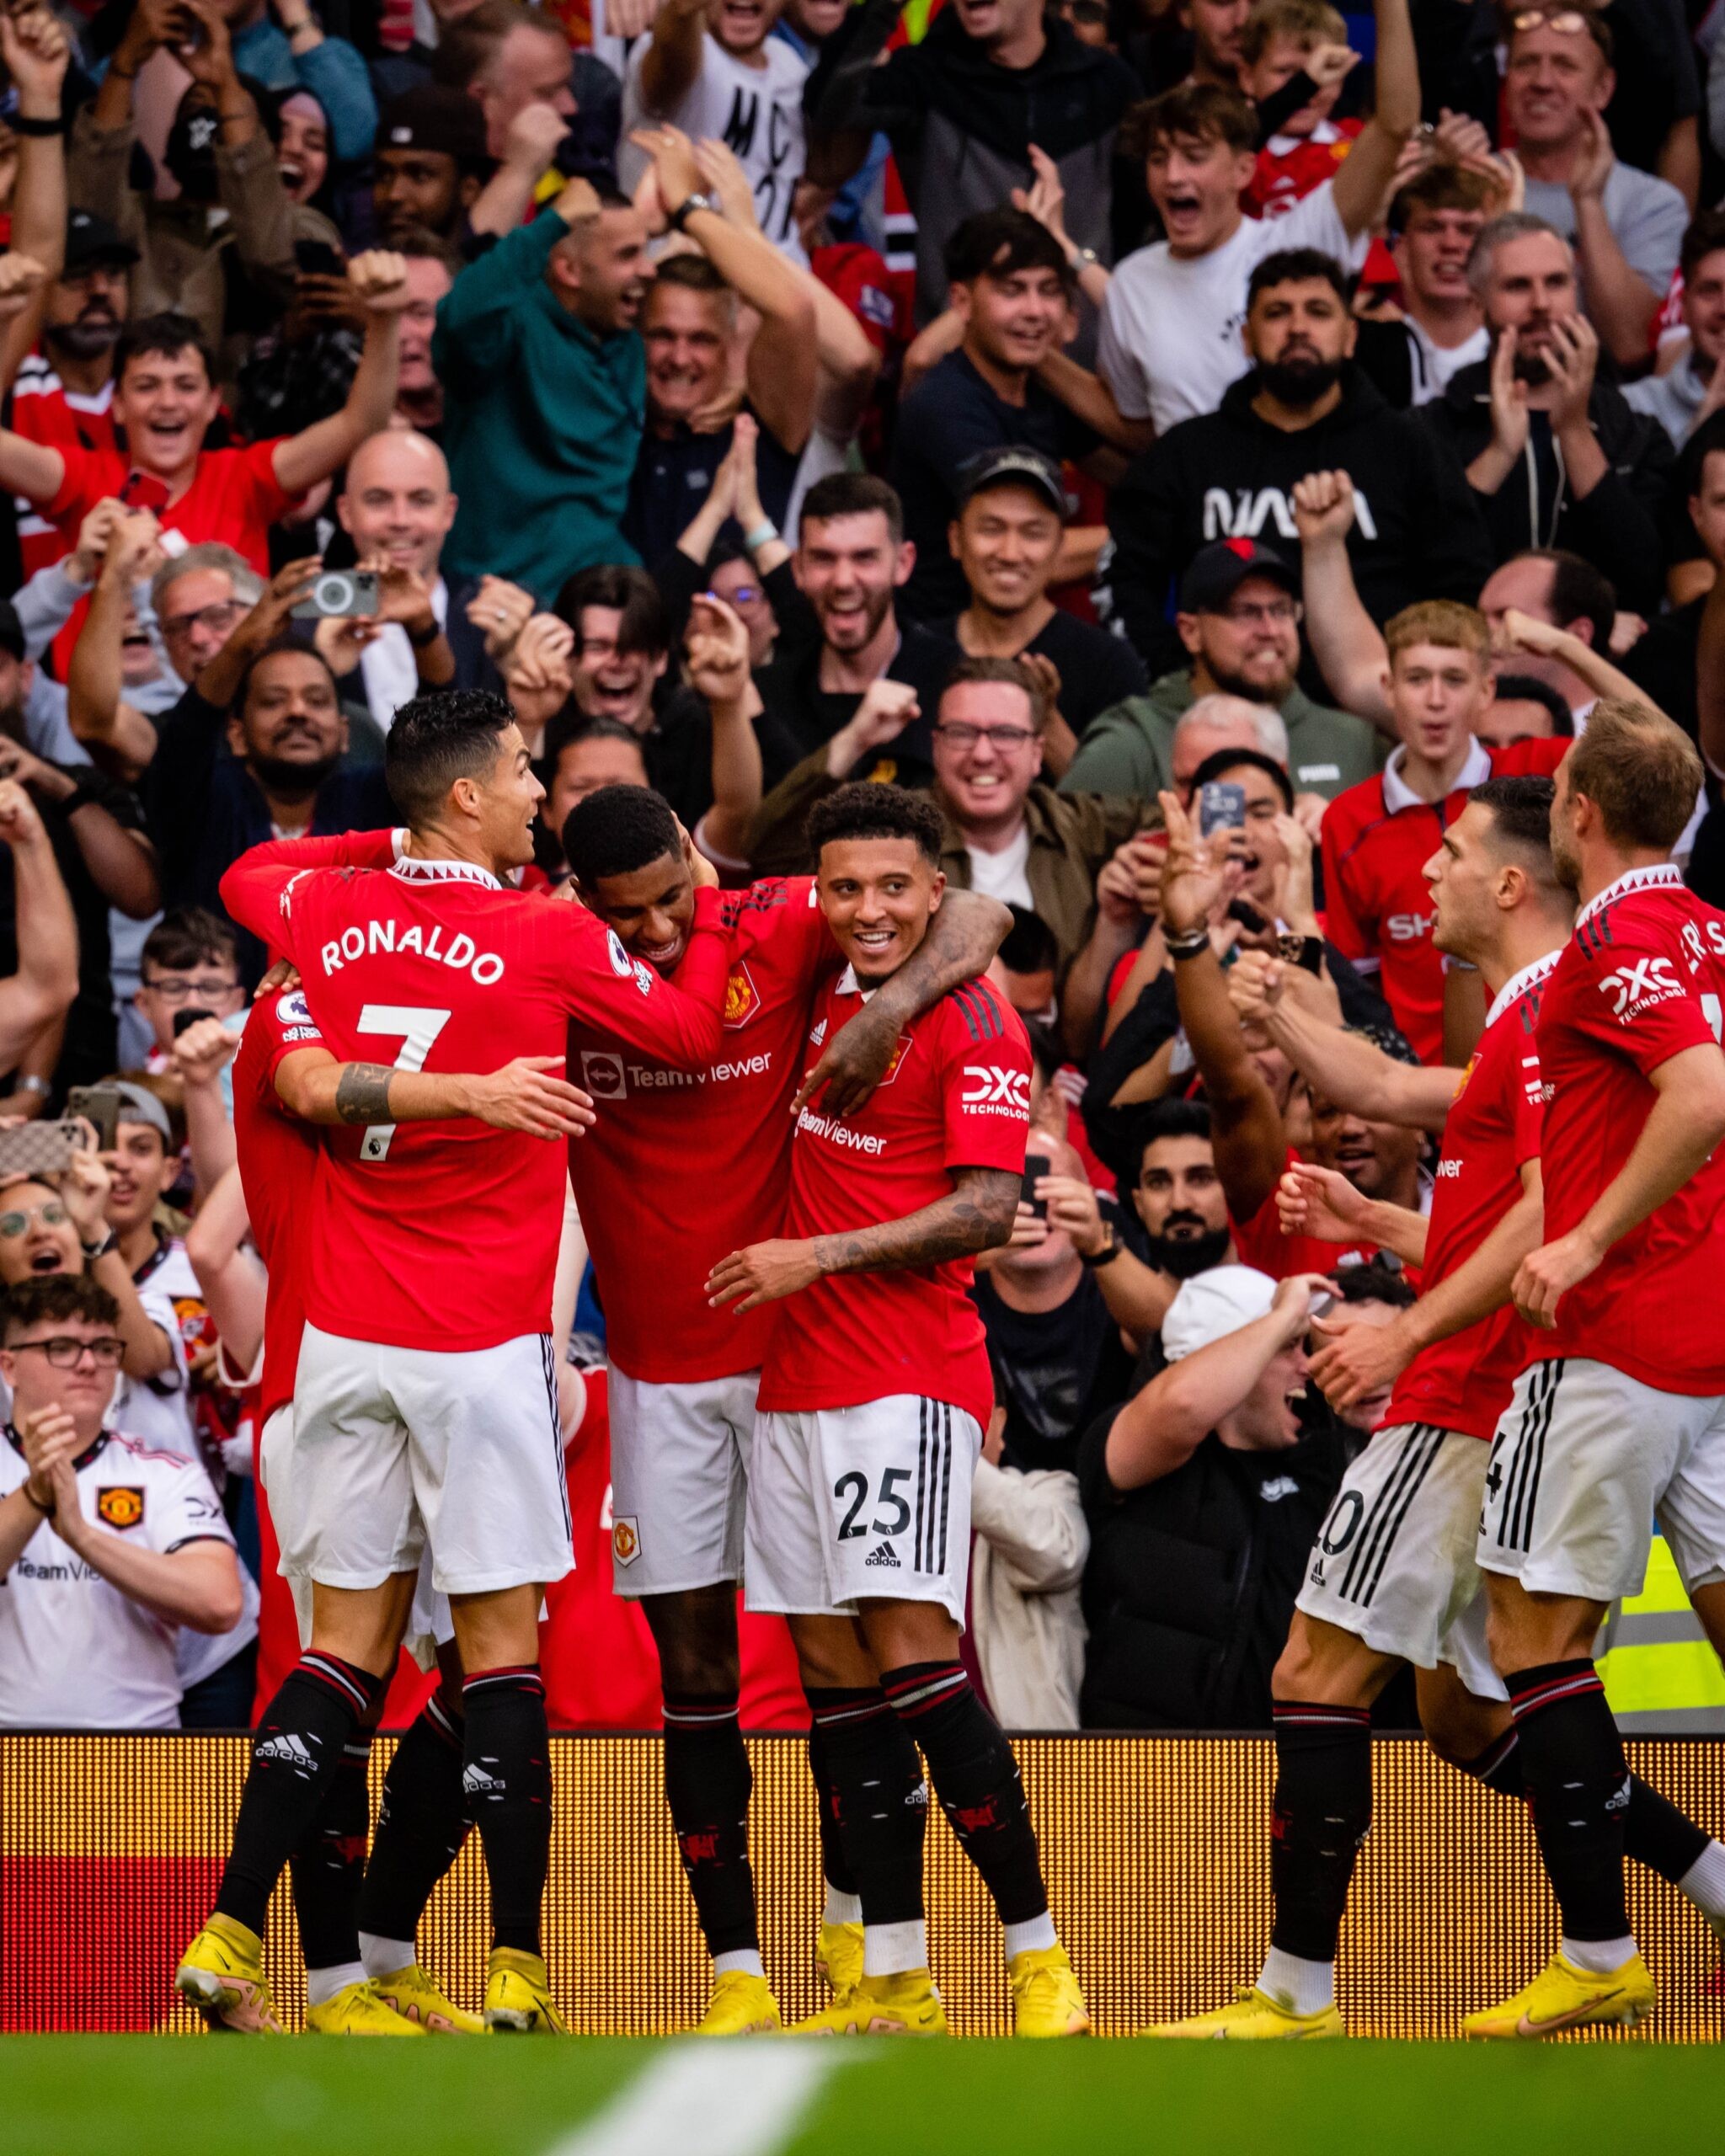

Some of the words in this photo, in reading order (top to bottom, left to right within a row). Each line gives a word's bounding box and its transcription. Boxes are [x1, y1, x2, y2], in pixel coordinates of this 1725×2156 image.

[1203, 487, 1378, 540] NA
[322, 920, 505, 985] RONALDO
[1598, 958, 1680, 1015] DXC
[1618, 988, 1686, 1025] TECHNOLOGY
[357, 1004, 451, 1161] 7
[962, 1065, 1029, 1110] DXC
[797, 1106, 887, 1155] TeamViewer
[835, 1467, 912, 1541] 25
[1315, 1490, 1365, 1556] 0
[865, 1556, 901, 1568] adidas
[255, 1747, 318, 1771] adidas
